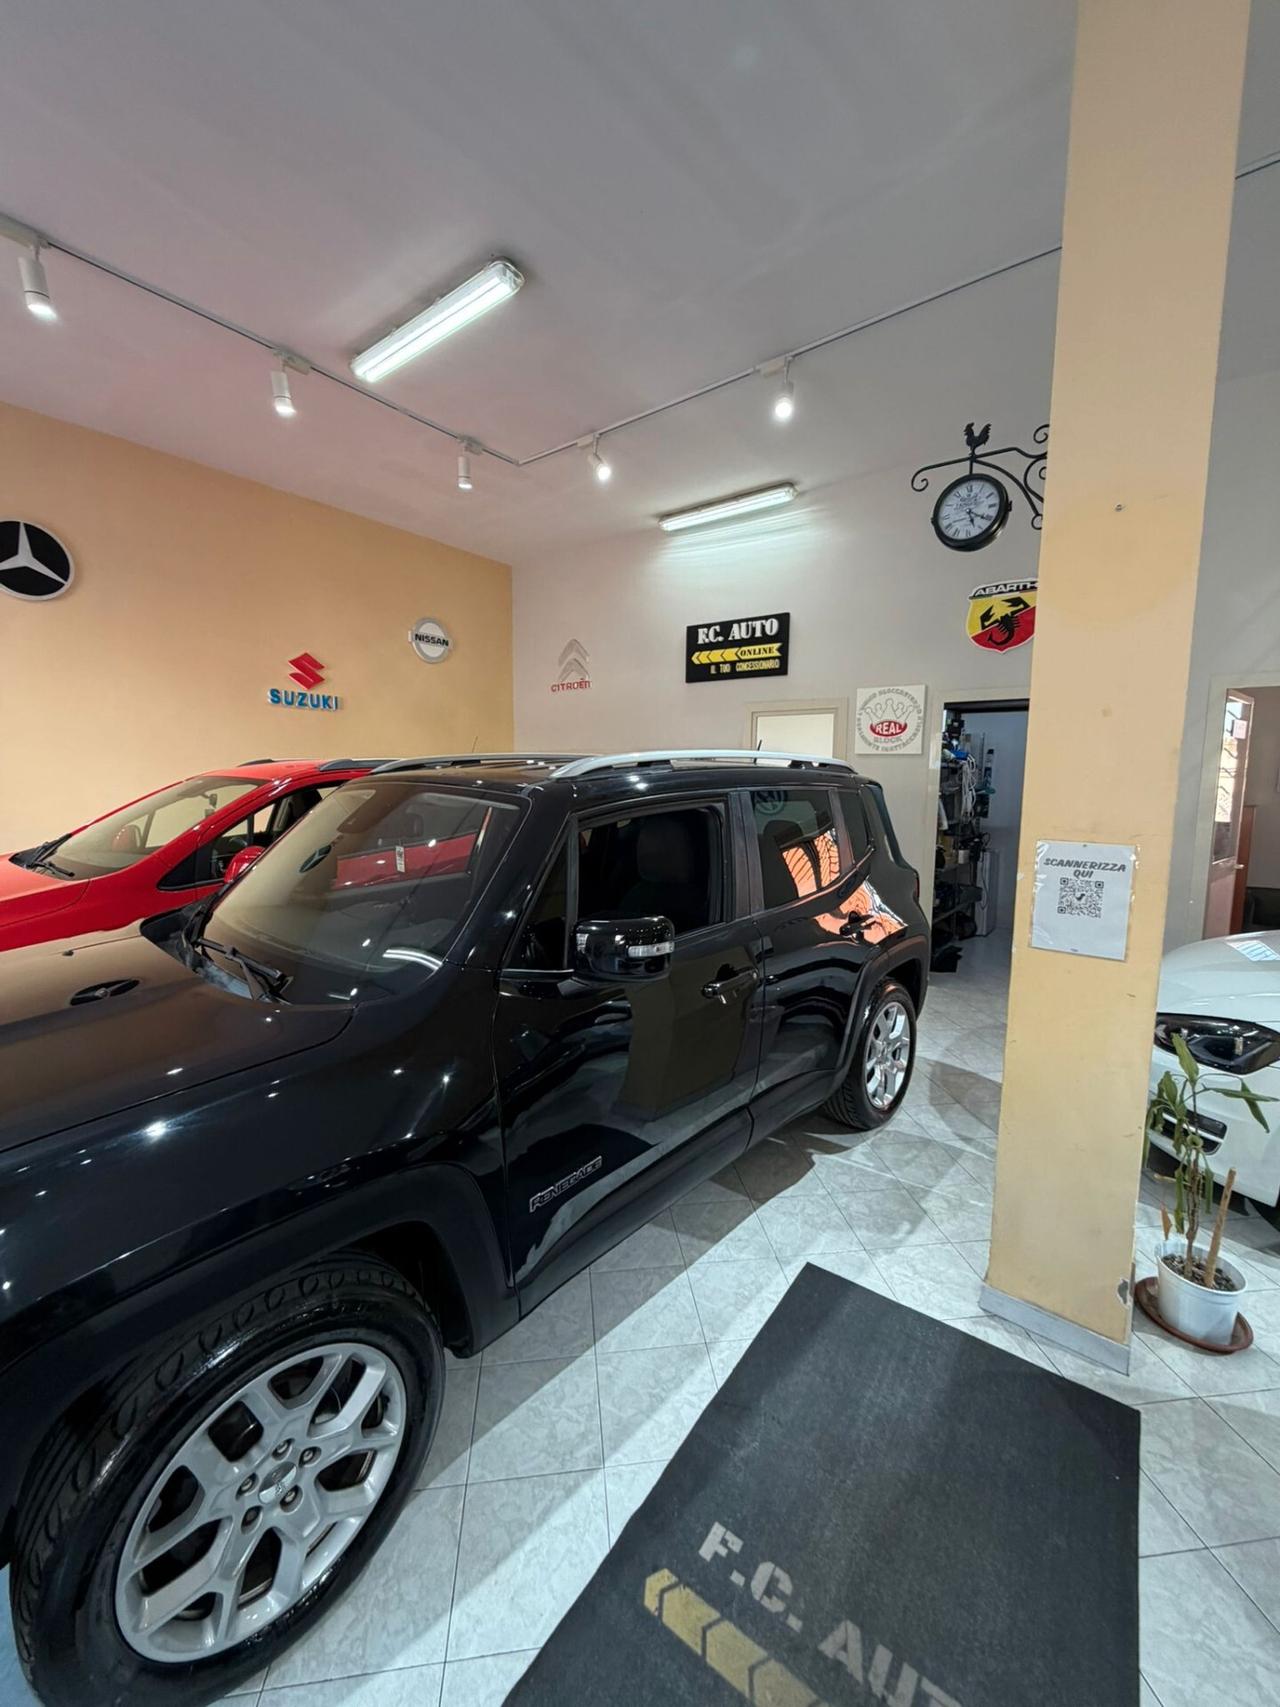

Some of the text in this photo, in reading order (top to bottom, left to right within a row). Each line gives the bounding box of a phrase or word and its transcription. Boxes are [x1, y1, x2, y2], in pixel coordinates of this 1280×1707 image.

[697, 618, 779, 645] F.C. AUTO
[414, 633, 449, 647] NISSAN
[740, 646, 775, 657] ONLINE
[267, 688, 338, 711] SUZUKI
[875, 722, 902, 735] REAL
[1043, 858, 1127, 873] SCANNERIZZA
[1073, 869, 1094, 879] QUI
